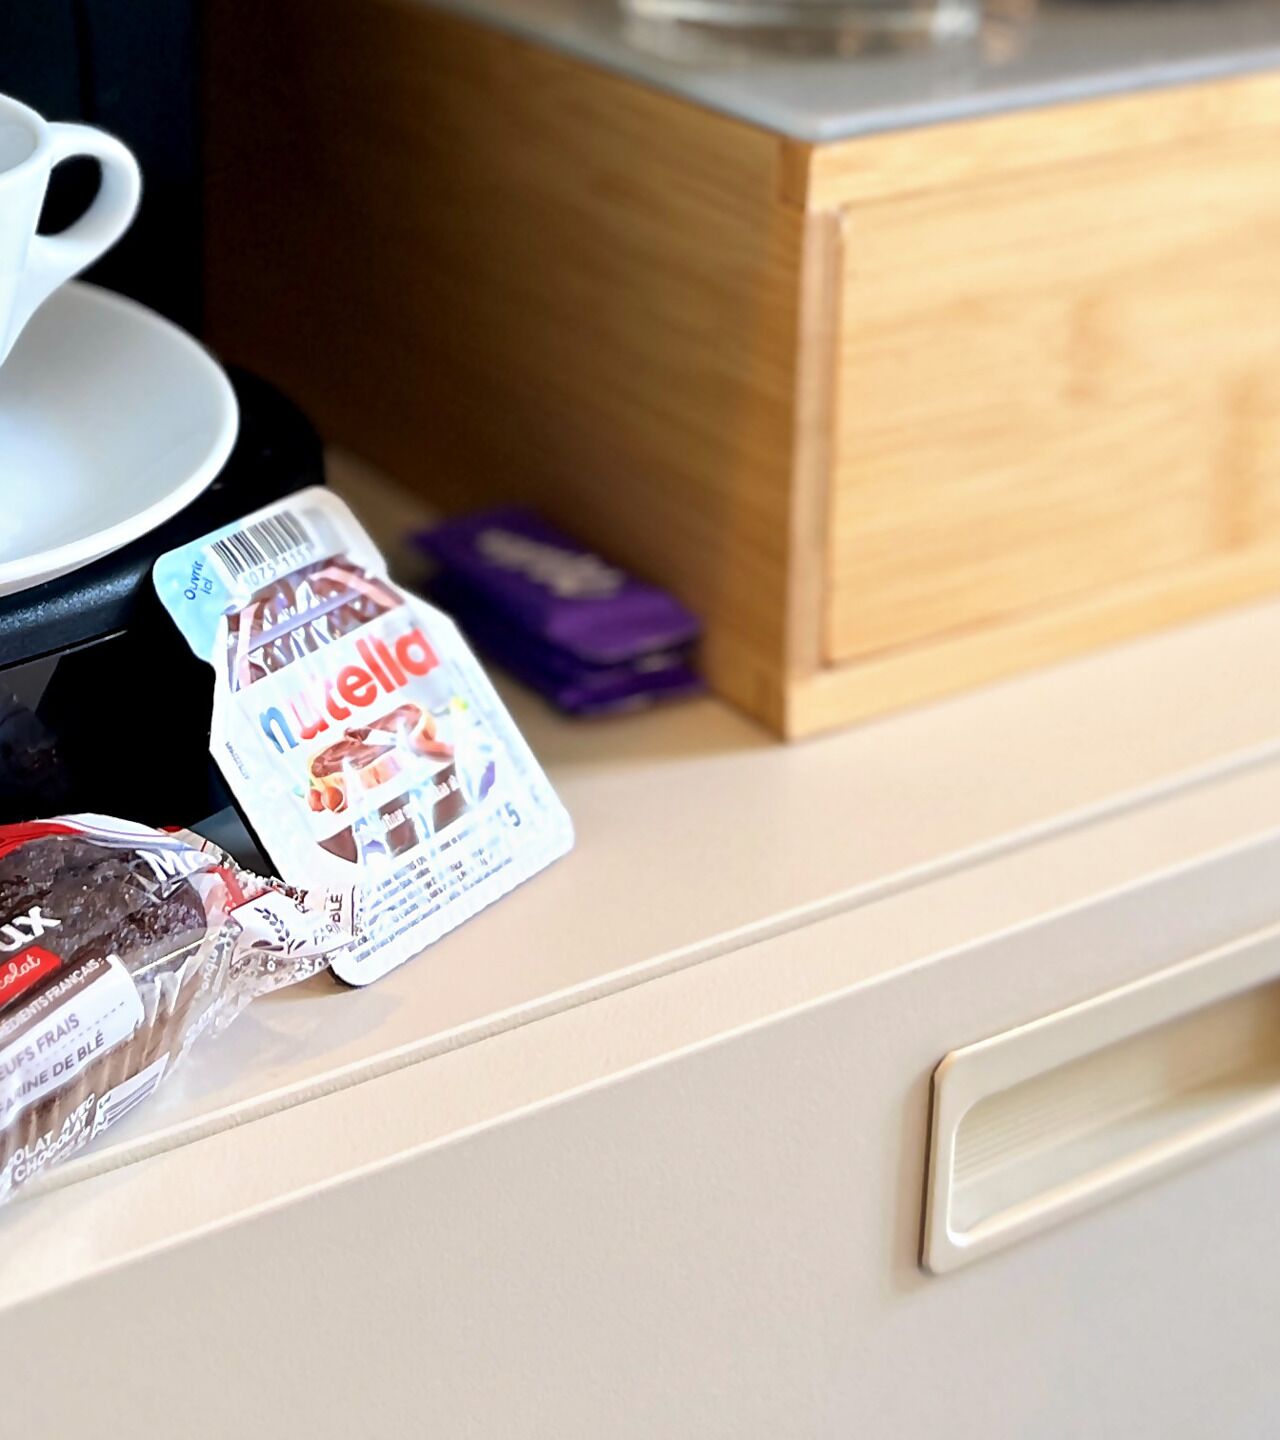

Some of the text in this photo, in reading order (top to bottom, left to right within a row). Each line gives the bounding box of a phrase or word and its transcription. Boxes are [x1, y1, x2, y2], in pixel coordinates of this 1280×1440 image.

[183, 561, 205, 601] Ouvrir
[259, 627, 440, 753] nutella
[35, 1013, 80, 1053] FRAIS
[52, 1055, 75, 1077] DE
[77, 1029, 105, 1063] BLÉ
